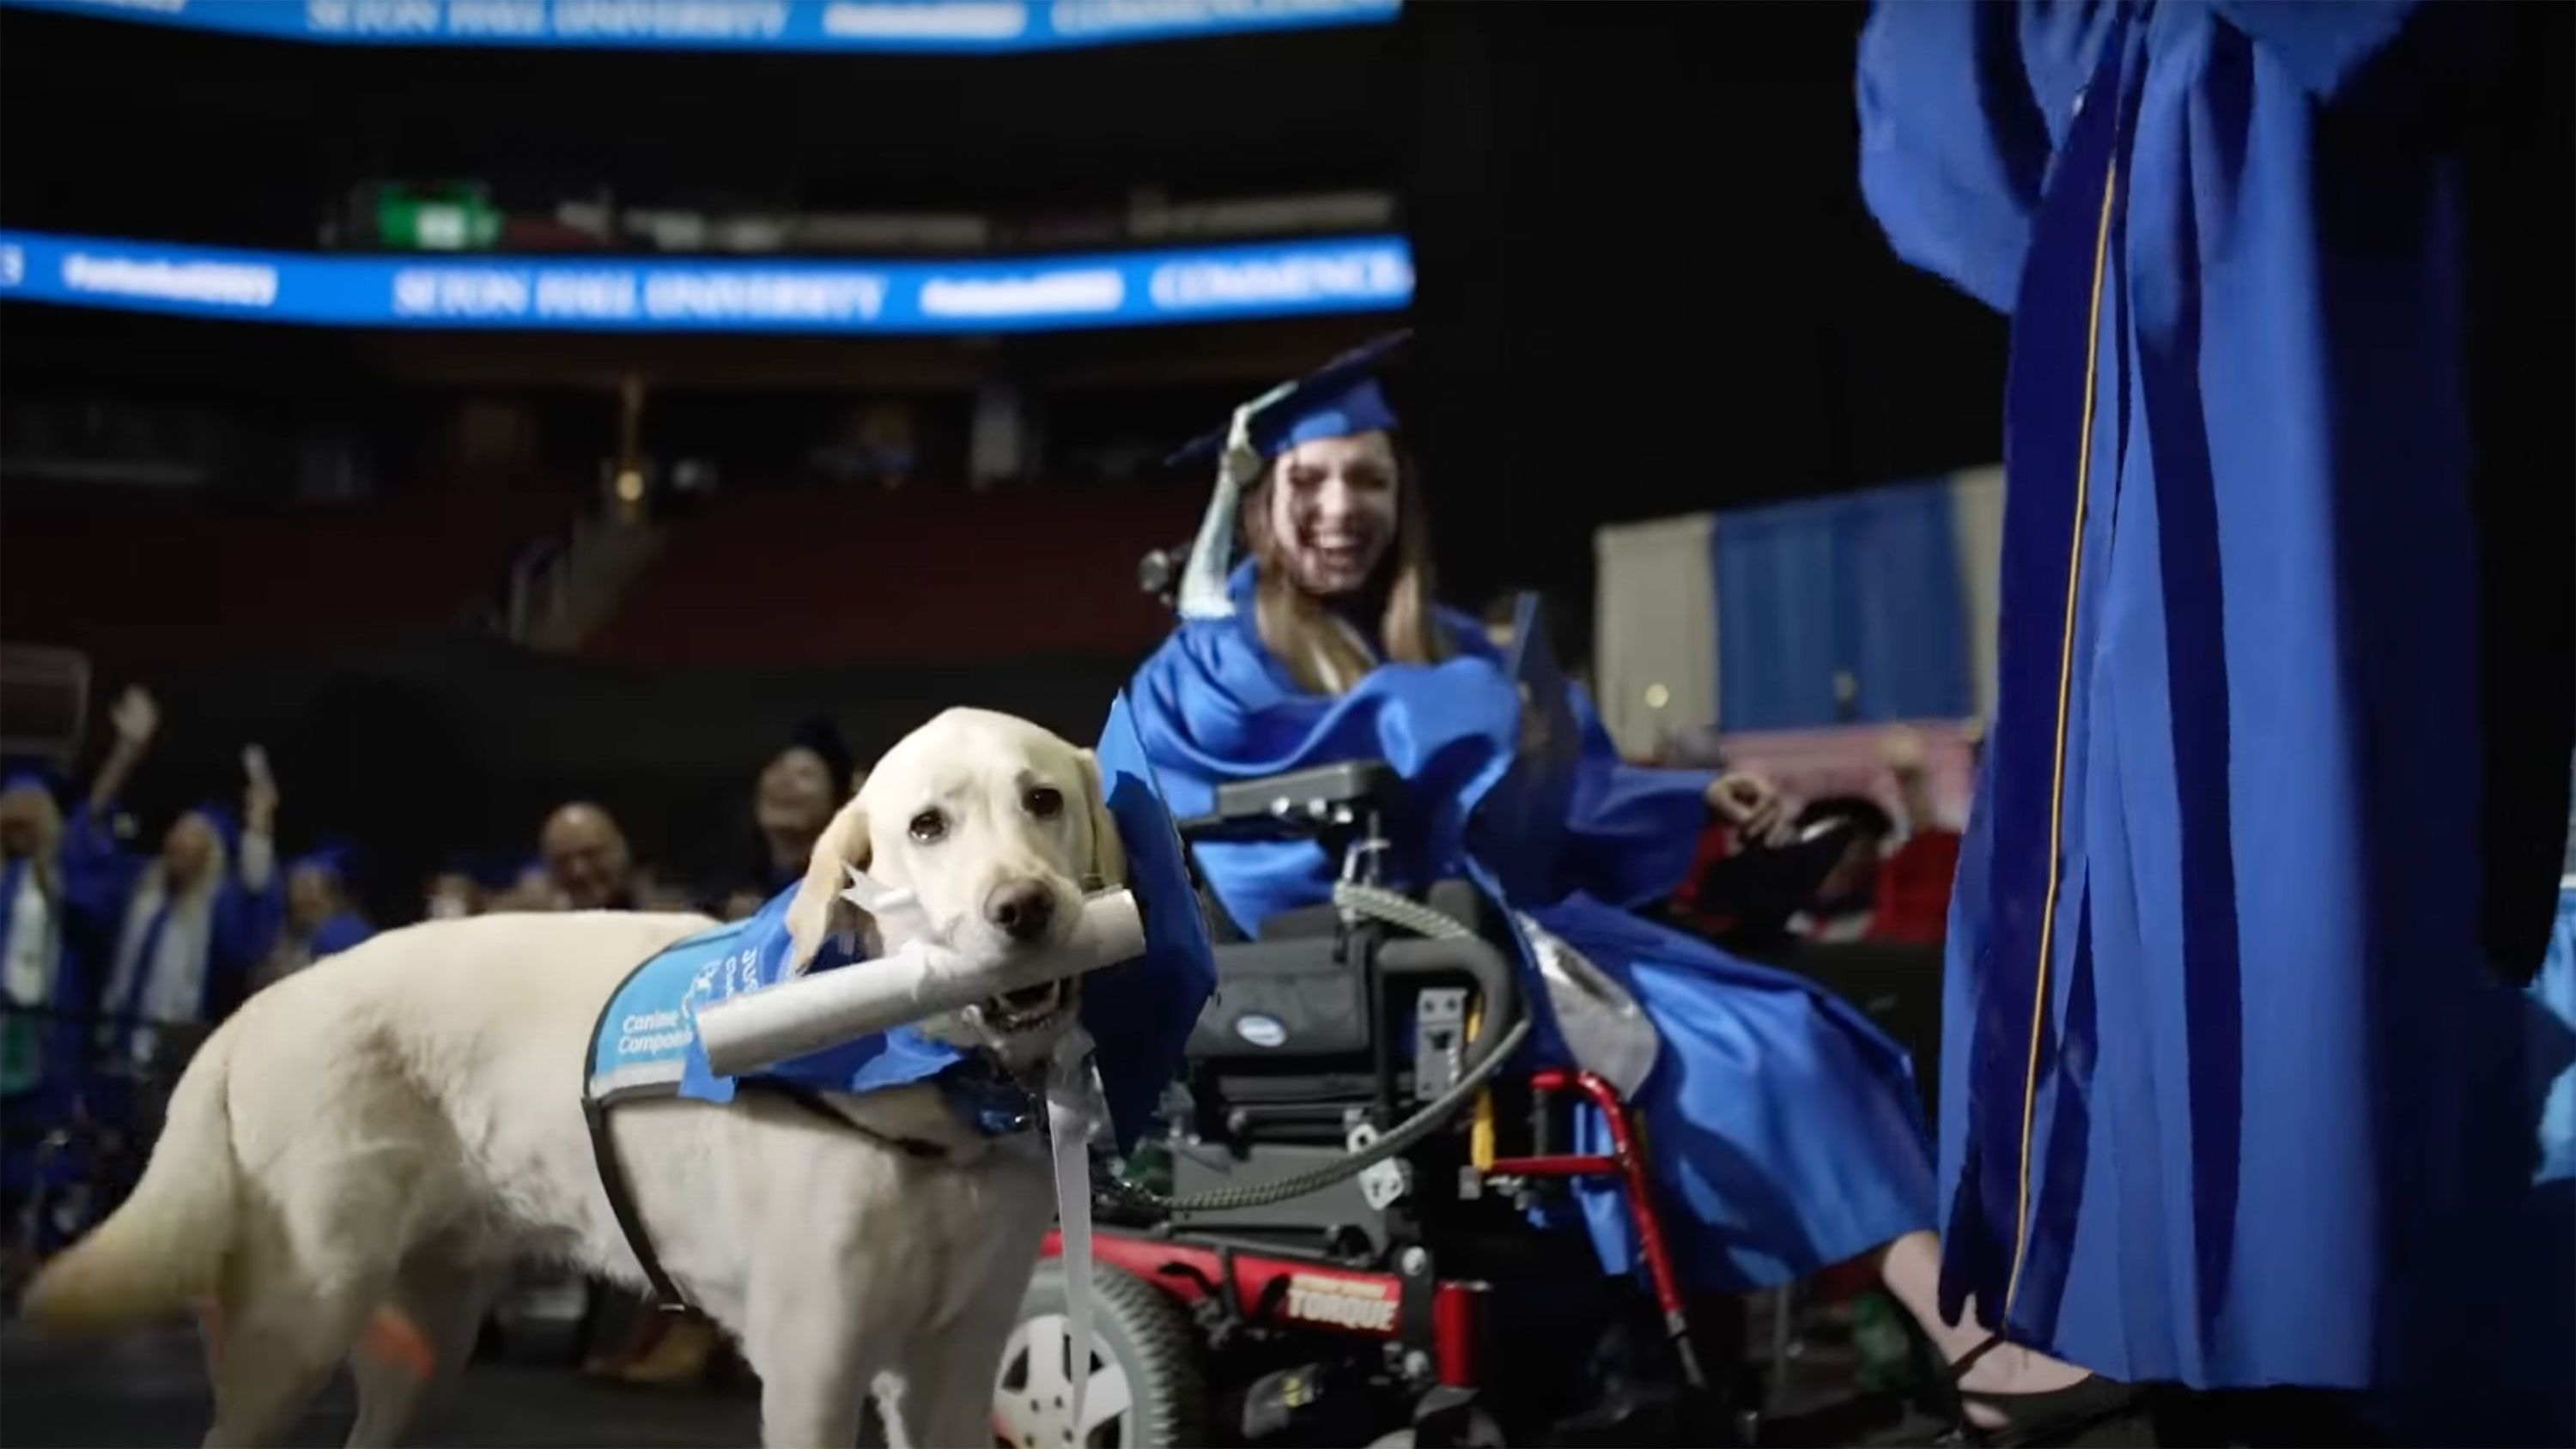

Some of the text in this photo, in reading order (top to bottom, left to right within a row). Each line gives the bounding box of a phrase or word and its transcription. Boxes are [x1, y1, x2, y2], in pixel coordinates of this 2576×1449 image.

[393, 269, 530, 318] SETON
[536, 270, 637, 318] HALL
[644, 270, 888, 321] UNIVERSITY
[623, 1010, 677, 1034] Canine
[1286, 1288, 1400, 1331] TORQUE
